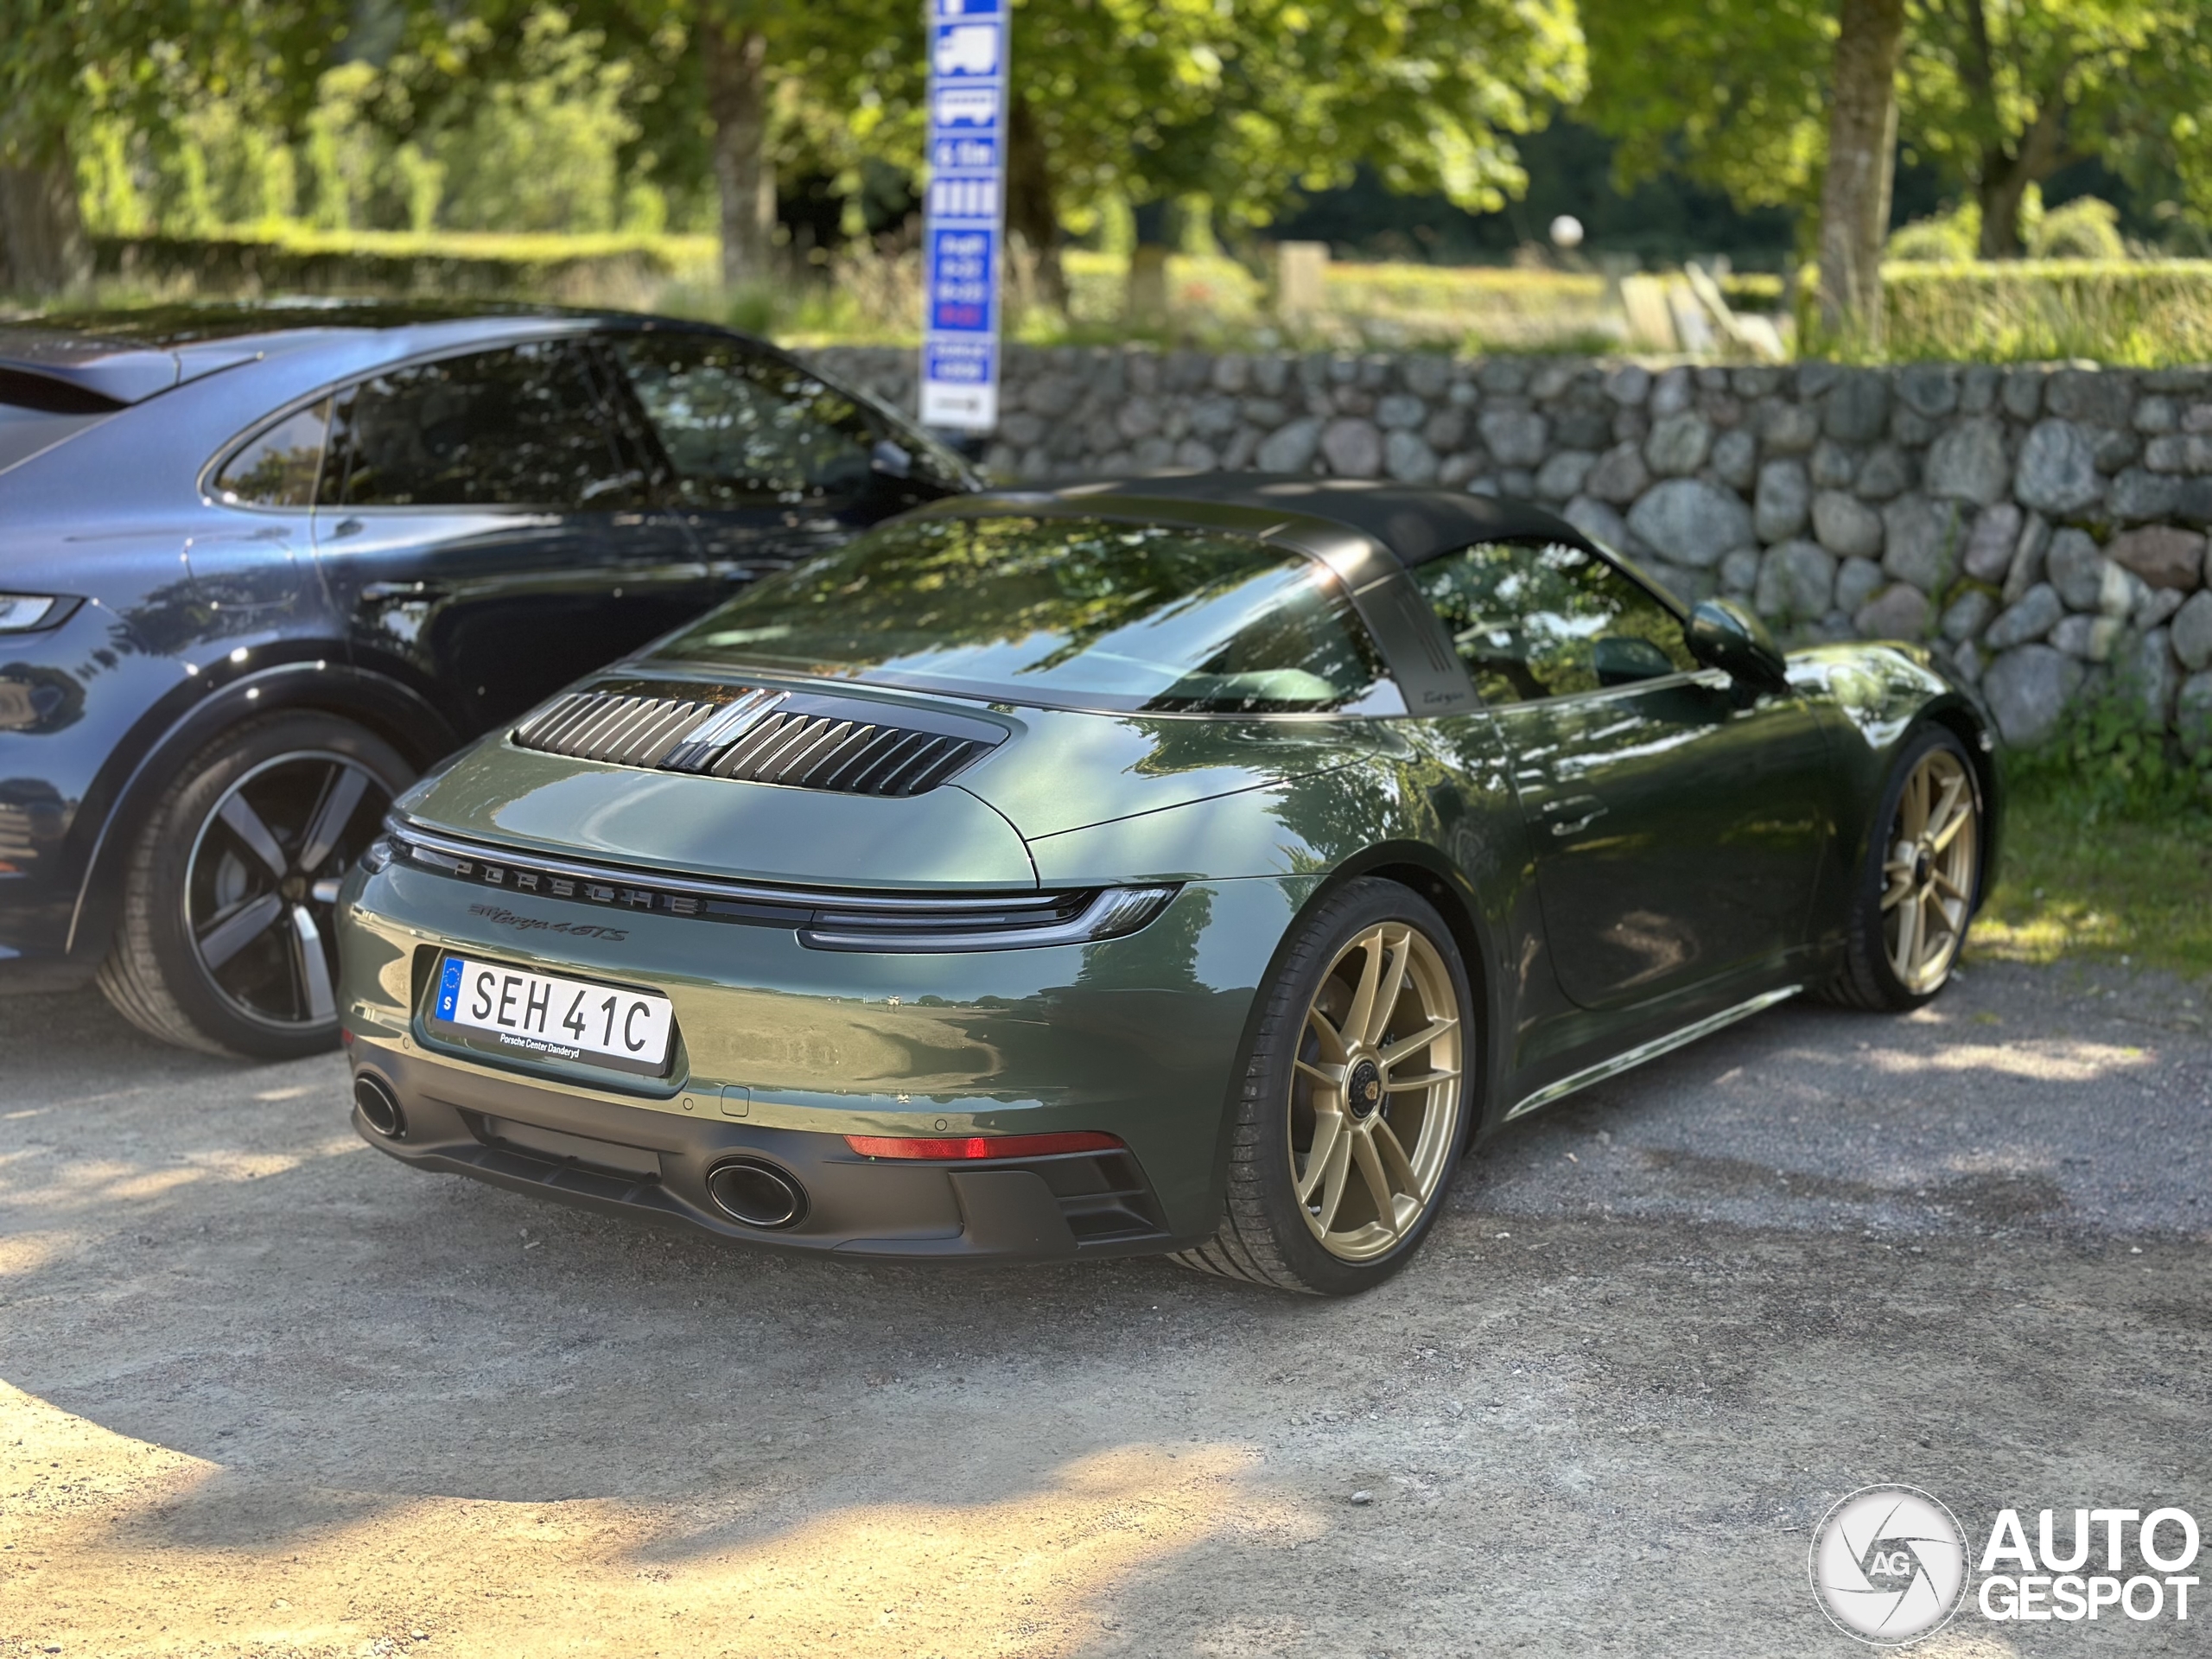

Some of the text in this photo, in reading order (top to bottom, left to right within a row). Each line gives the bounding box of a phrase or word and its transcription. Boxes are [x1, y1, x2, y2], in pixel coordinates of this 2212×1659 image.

[454, 861, 699, 915] PORSCHE
[490, 906, 550, 931] Targa
[570, 924, 629, 942] GTS
[443, 996, 452, 1010] S
[472, 971, 651, 1052] SEH 41C
[499, 1033, 581, 1059] Porsche Center Danderyd
